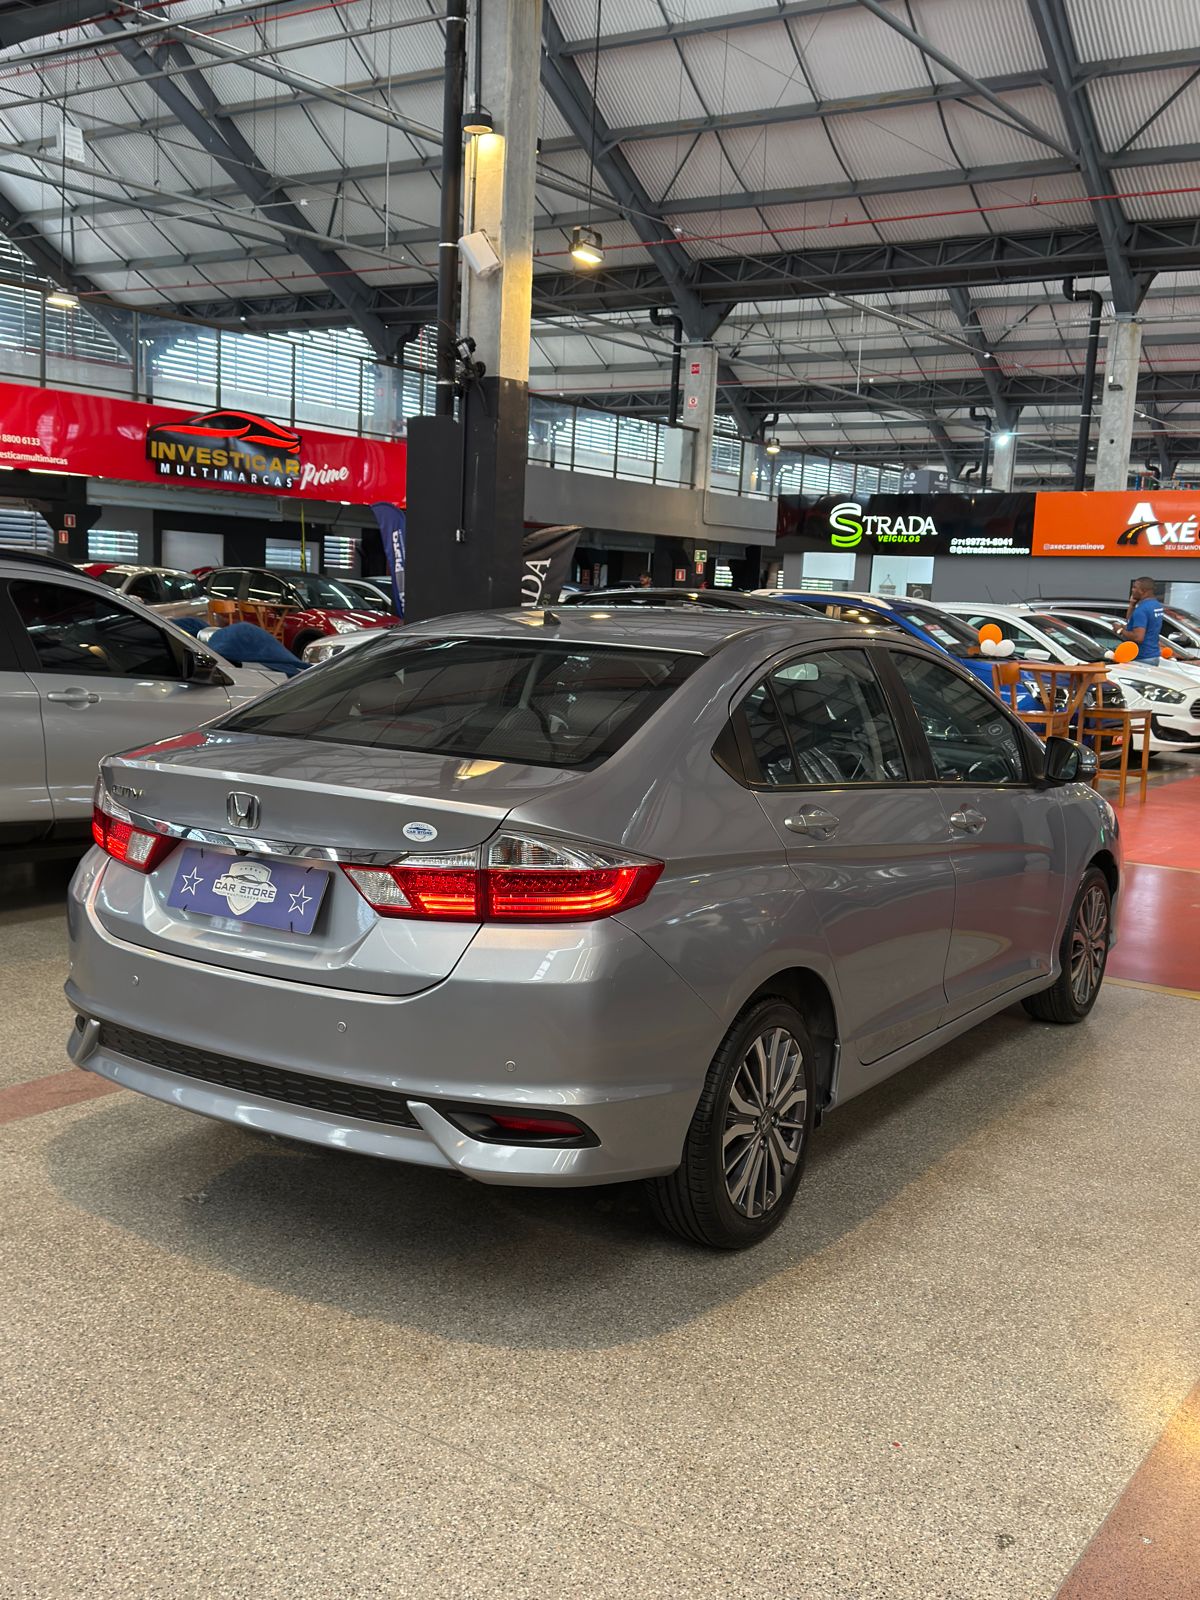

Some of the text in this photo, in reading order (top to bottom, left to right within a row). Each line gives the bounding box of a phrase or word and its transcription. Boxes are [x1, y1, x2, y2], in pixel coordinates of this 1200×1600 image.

[22, 436, 41, 446] 6133
[151, 441, 300, 475] INVESTICAR
[160, 462, 293, 488] MULTIMARCAS
[300, 463, 349, 490] Prime
[829, 502, 938, 547] STRADA
[214, 881, 275, 899] CAR STORE
